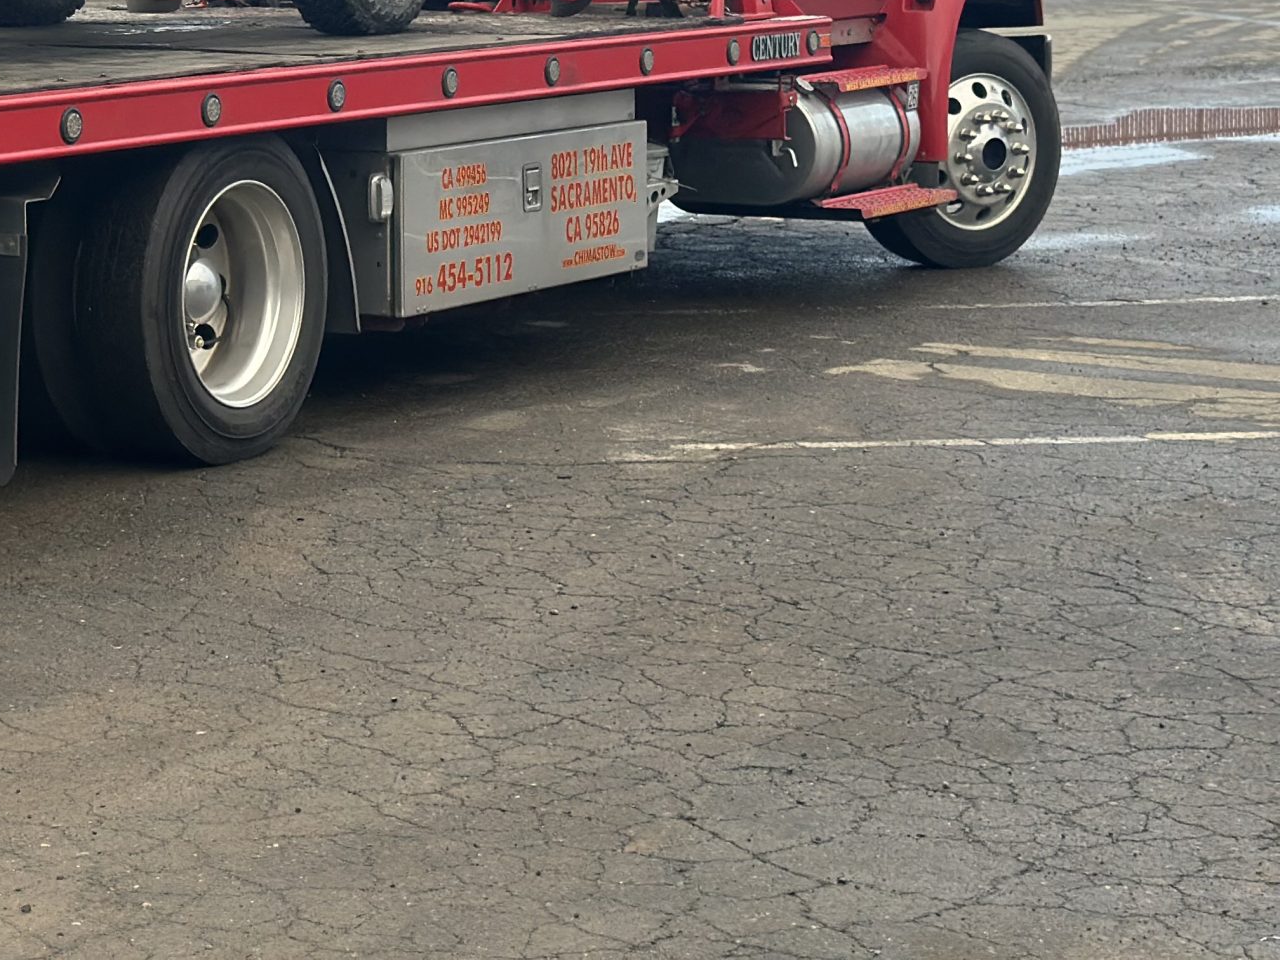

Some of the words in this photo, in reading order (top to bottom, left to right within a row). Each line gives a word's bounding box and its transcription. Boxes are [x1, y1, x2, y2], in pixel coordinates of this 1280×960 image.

[752, 31, 801, 61] CENTURY
[551, 149, 578, 180] 8021
[583, 144, 608, 175] 19th
[610, 142, 633, 171] AVE
[441, 167, 454, 189] CA
[550, 174, 637, 213] SACRAMENTO,
[439, 198, 454, 220] MC
[456, 192, 490, 216] 995249
[426, 232, 439, 253] US
[441, 227, 461, 251] DOT
[463, 220, 503, 248] 2942199
[566, 215, 582, 243] CA
[585, 209, 620, 239] 95826
[415, 276, 433, 297] 916
[436, 252, 513, 293] 454-5112
